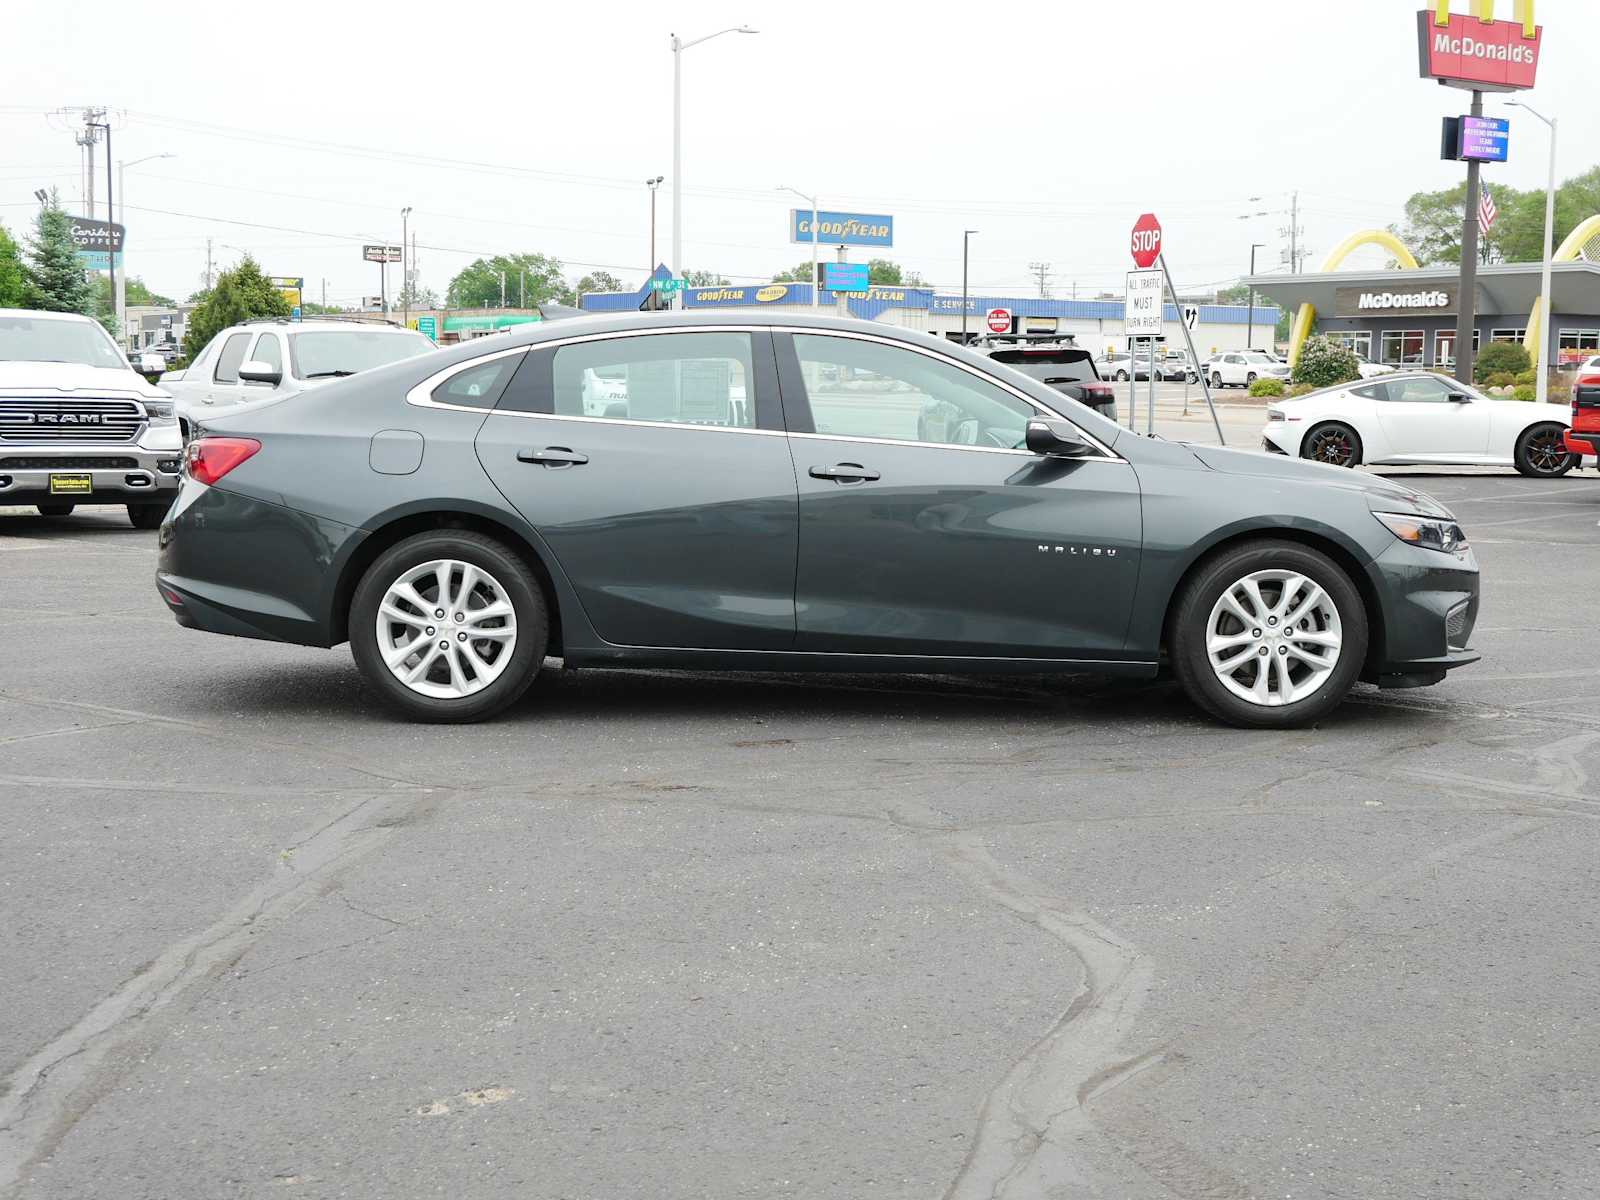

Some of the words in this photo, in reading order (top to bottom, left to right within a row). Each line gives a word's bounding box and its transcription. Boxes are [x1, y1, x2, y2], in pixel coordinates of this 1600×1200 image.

[1434, 33, 1534, 64] McDonald's
[71, 225, 120, 237] Caribou
[799, 219, 889, 238] GOODYEAR
[73, 237, 119, 246] COFFEE
[1132, 230, 1160, 252] STOP
[1129, 279, 1138, 289] ALL
[1140, 278, 1160, 289] TRAFFIC
[697, 289, 744, 302] GOODYEAR
[1358, 291, 1449, 309] McDonald's
[942, 300, 976, 310] SERVCE
[1134, 297, 1153, 309] MUST
[1127, 317, 1141, 328] TURN
[1142, 316, 1160, 328] RIGHT
[37, 413, 100, 423] RAM
[1037, 544, 1116, 557] MALIBU
